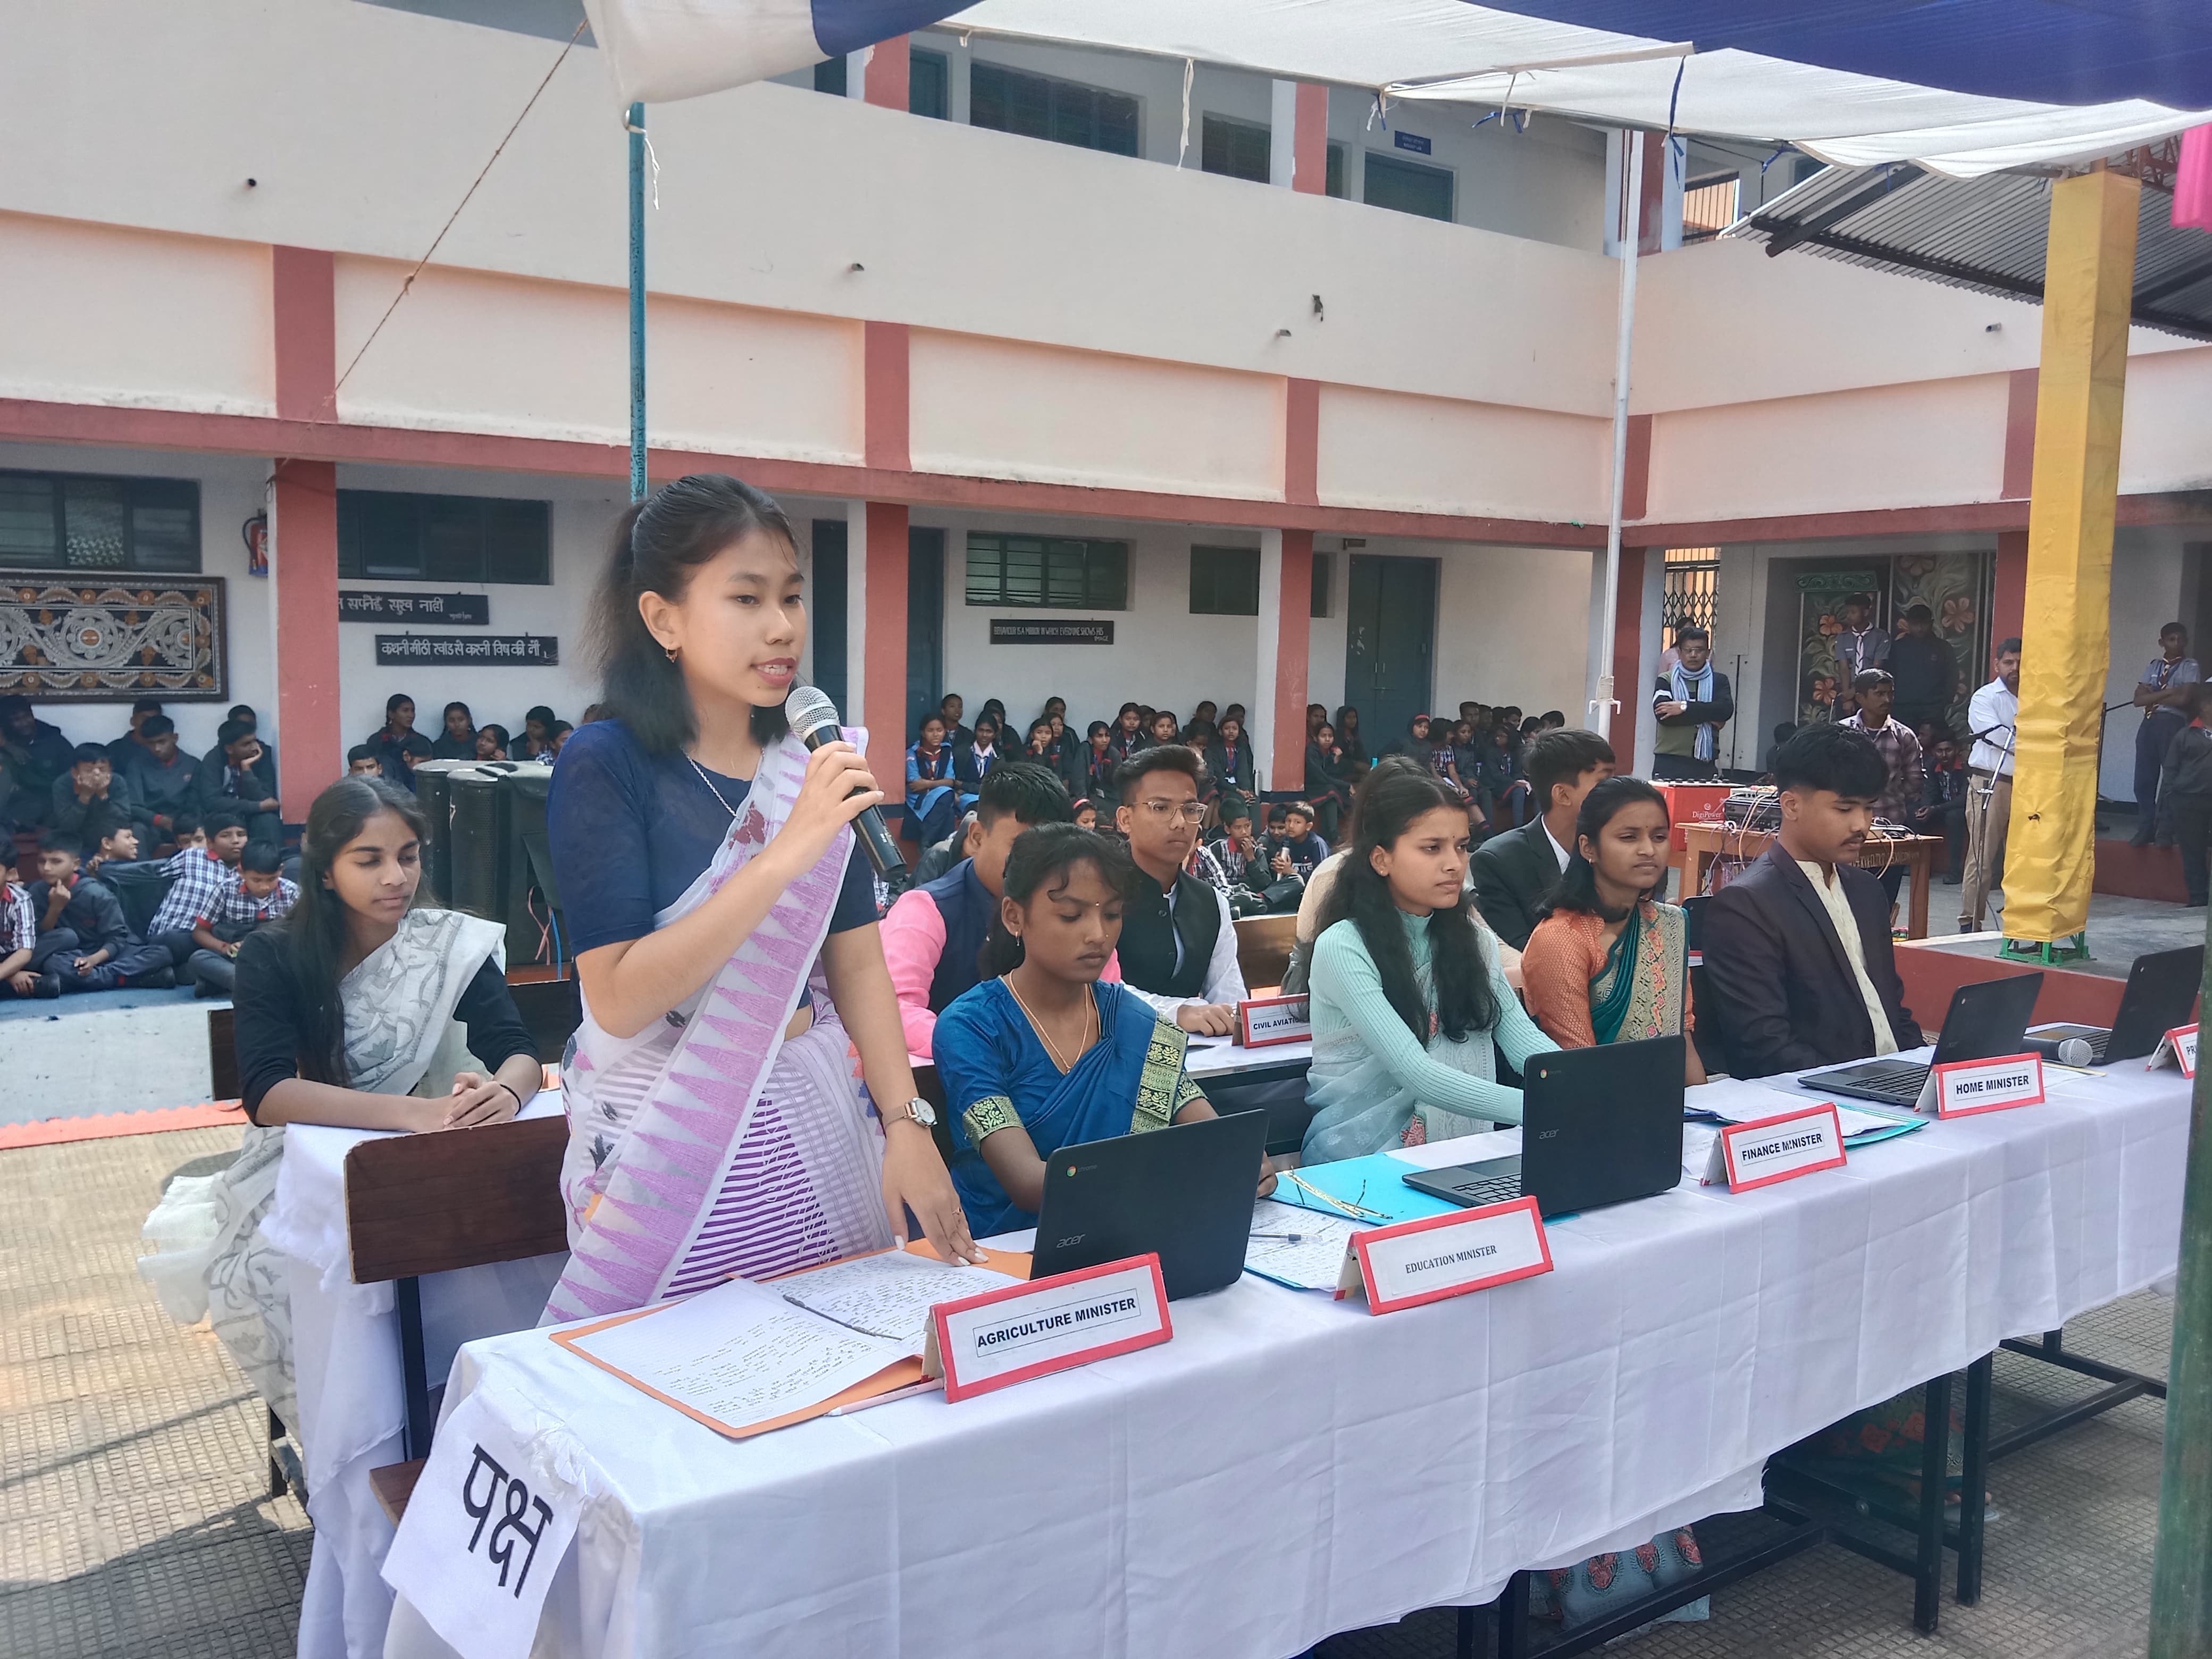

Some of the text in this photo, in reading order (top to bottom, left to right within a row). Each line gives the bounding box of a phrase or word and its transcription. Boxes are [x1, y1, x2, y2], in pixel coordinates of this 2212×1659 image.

[388, 598, 413, 615] सुख
[1253, 1020, 1271, 1030] CIVIL
[1956, 1075, 2029, 1095] HOME MINISTER
[1539, 1128, 1560, 1139] acer
[1742, 1133, 1822, 1161] FINANCE MINISTER
[1057, 1233, 1086, 1249] acer
[1405, 1245, 1497, 1275] EDUCATION MINISTER
[977, 1297, 1136, 1348] AGRICULTURE MINISTER
[463, 1443, 554, 1599] पक्ष
